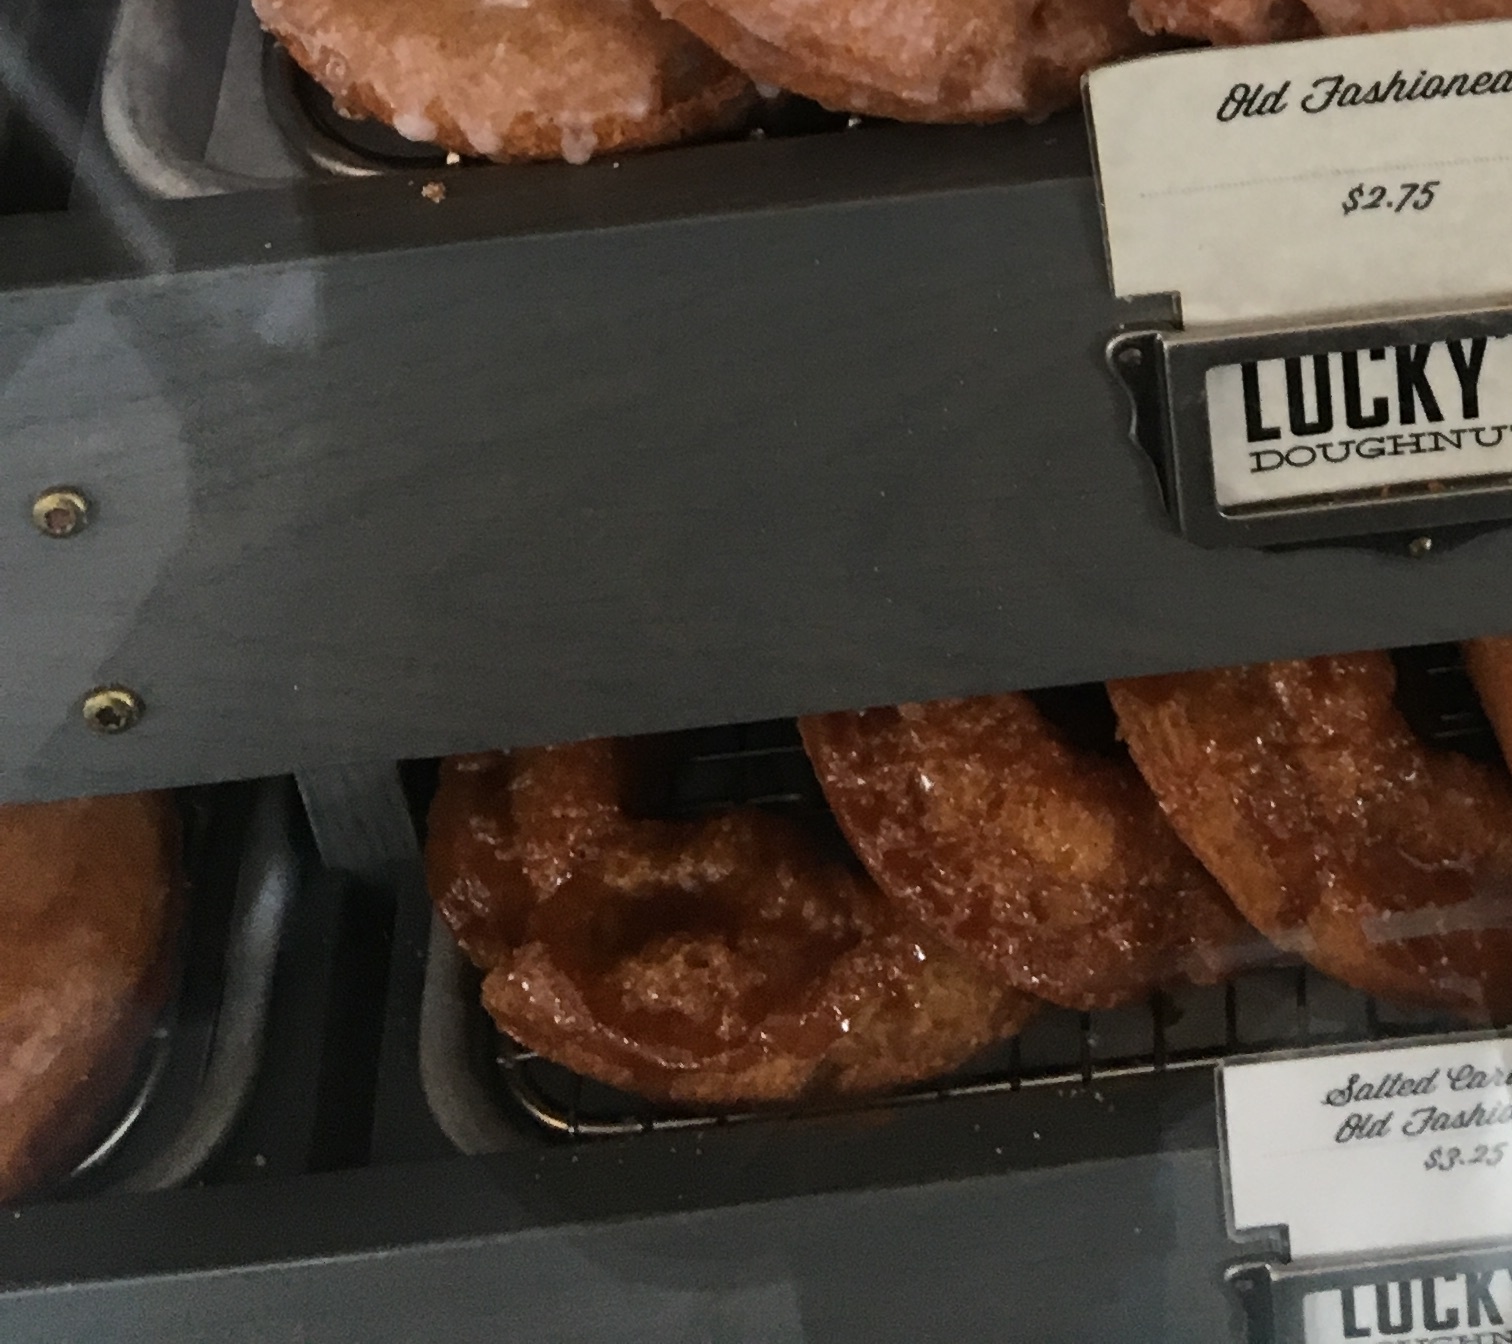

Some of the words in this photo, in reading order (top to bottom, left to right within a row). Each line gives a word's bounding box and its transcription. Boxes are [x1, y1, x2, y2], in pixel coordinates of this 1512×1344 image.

[1216, 81, 1291, 122] Old
[1342, 181, 1440, 215] $2.75
[1321, 1068, 1440, 1106] Salted
[1335, 1111, 1393, 1143] Old
[1424, 1142, 1508, 1171] $3.25
